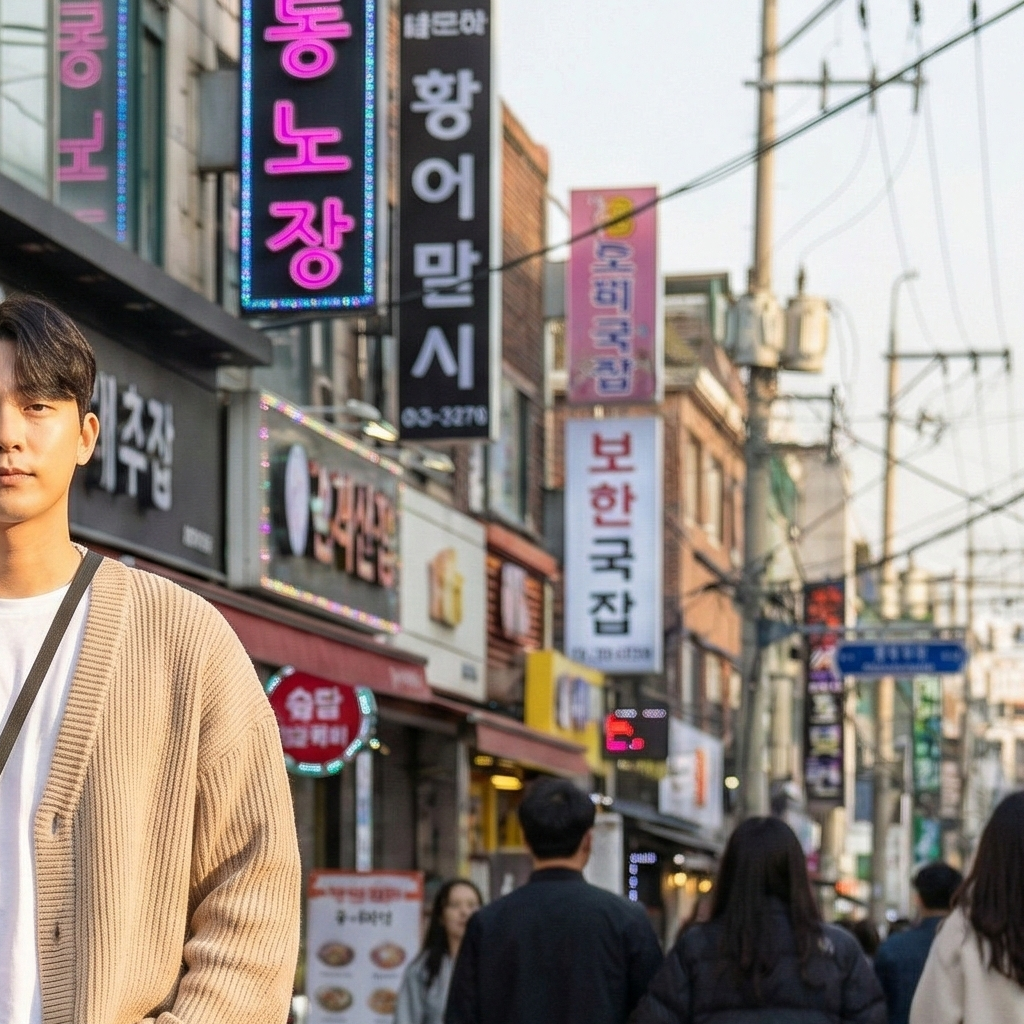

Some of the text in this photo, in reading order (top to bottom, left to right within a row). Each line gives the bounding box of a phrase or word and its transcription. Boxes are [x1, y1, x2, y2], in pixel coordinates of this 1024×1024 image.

[263, 0, 356, 290] 동노장
[409, 68, 482, 391] 황어말시
[589, 431, 637, 635] 보한국잡
